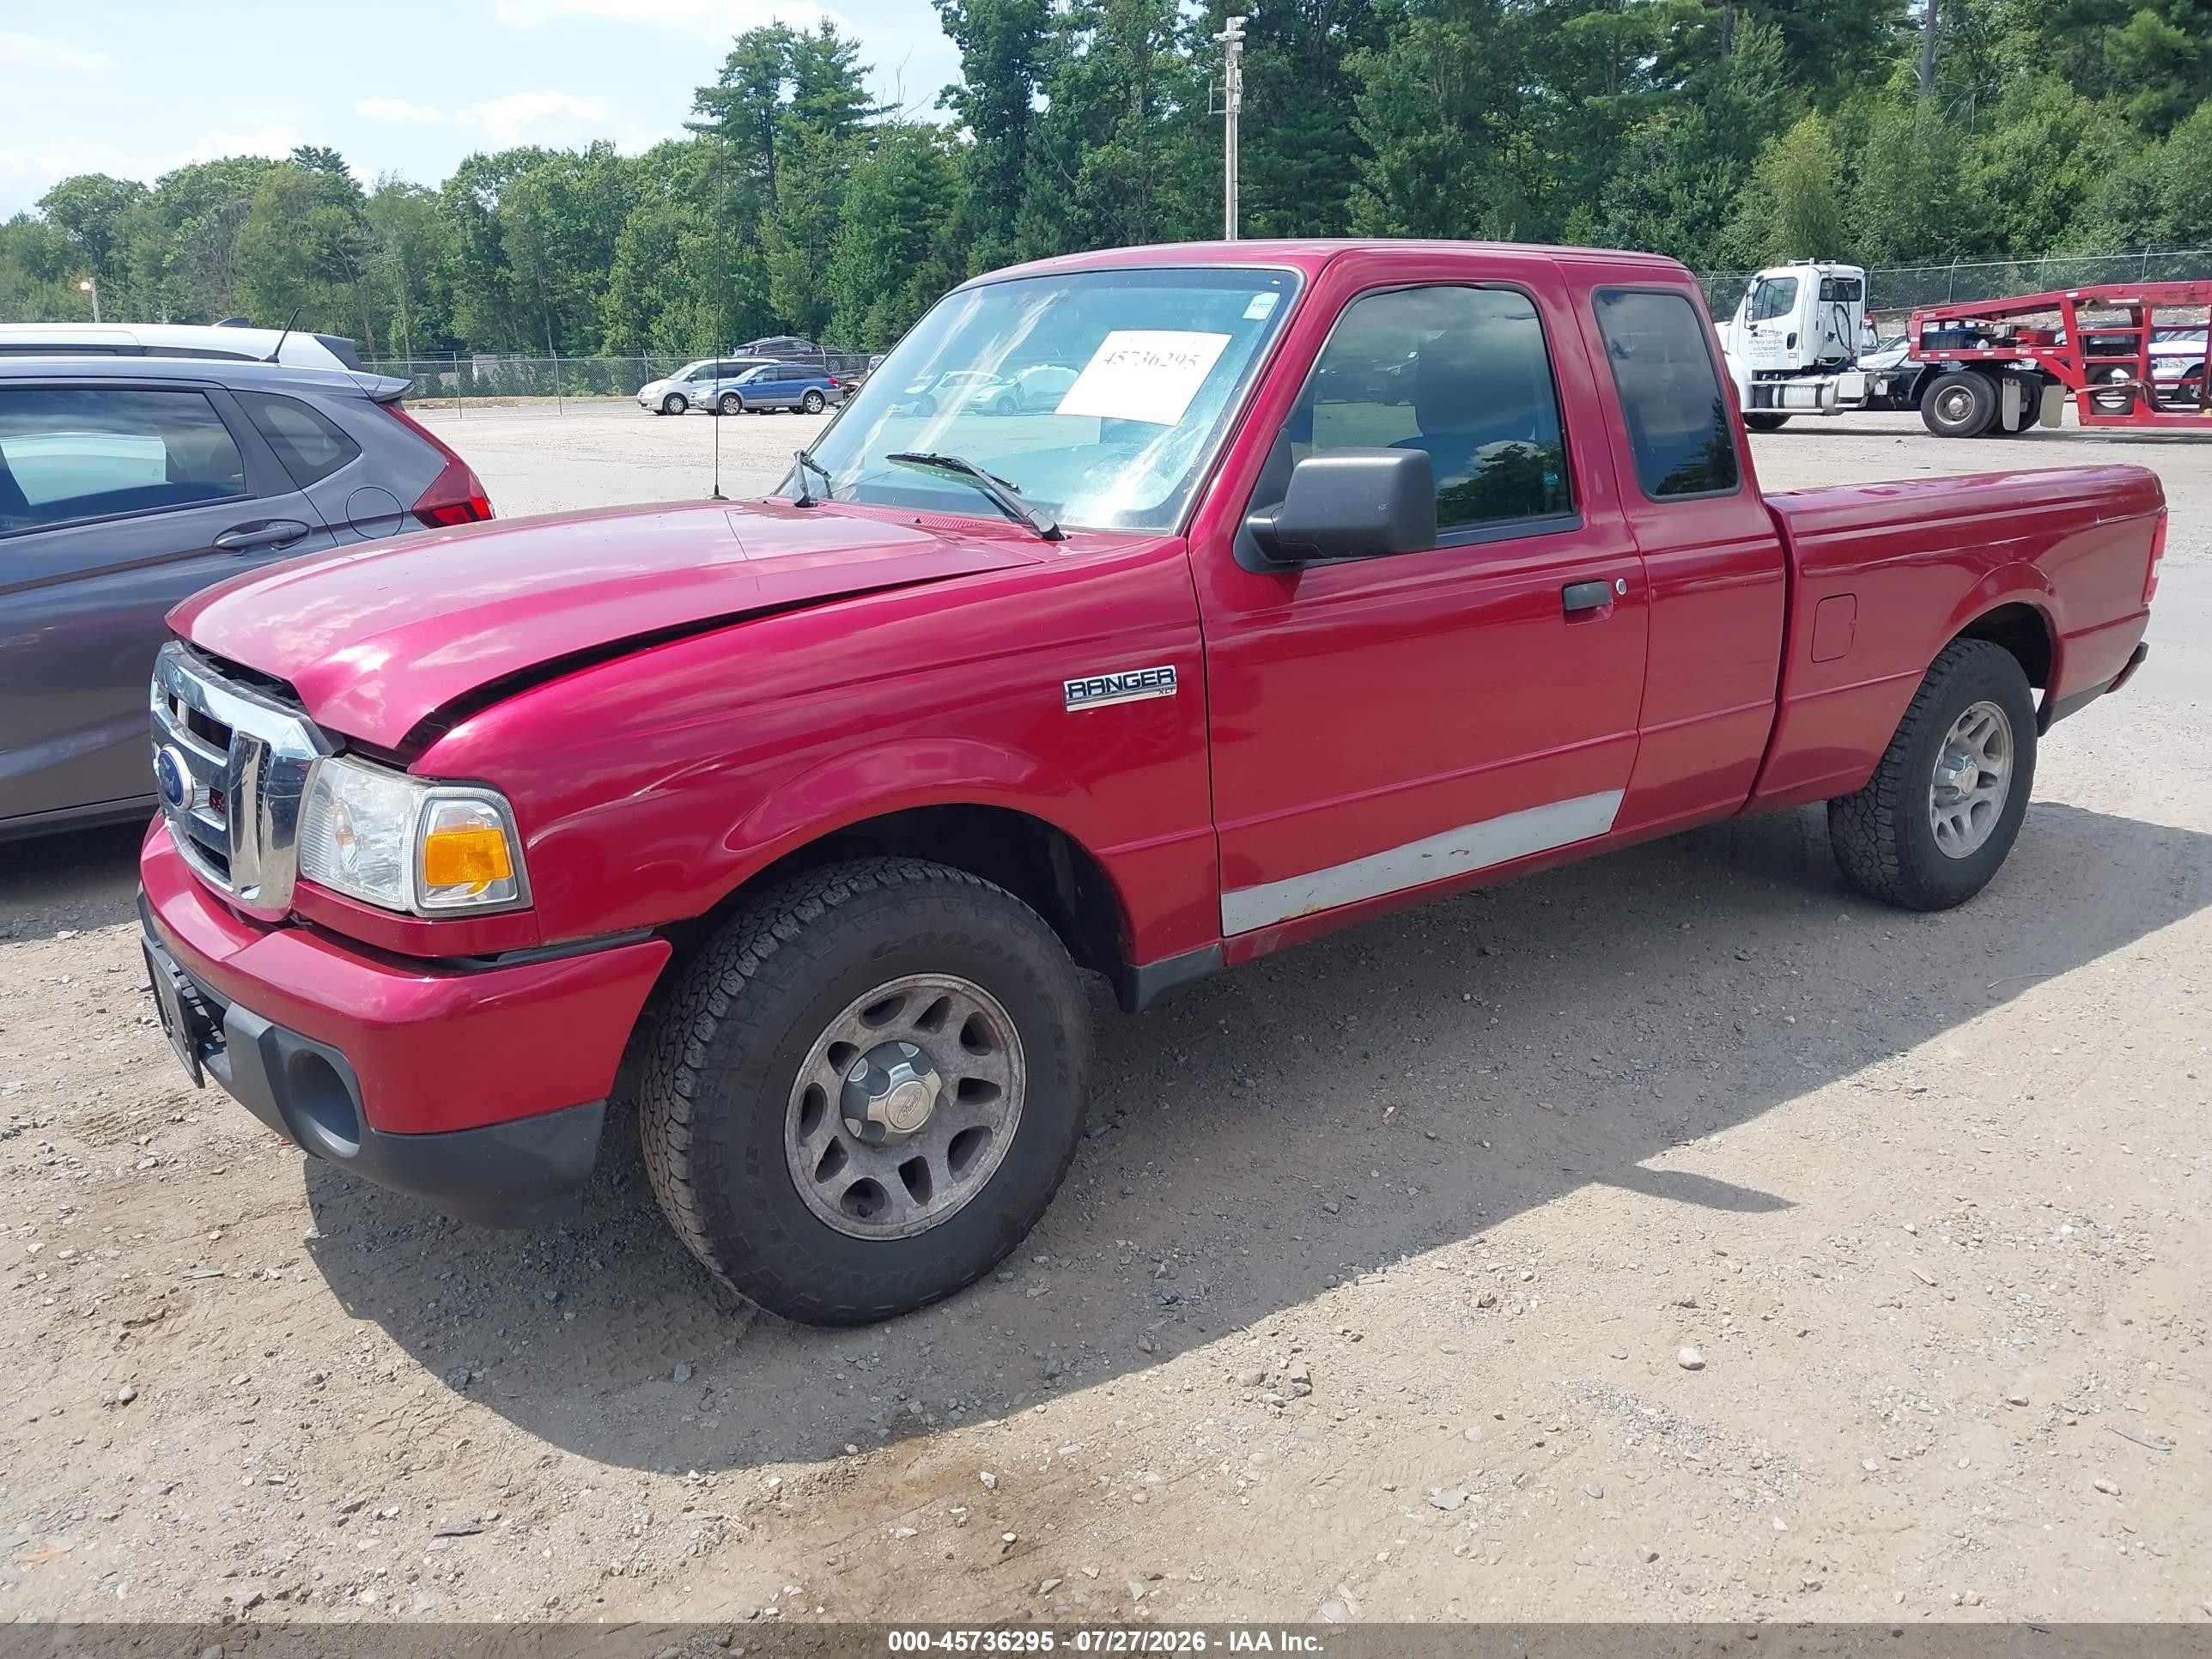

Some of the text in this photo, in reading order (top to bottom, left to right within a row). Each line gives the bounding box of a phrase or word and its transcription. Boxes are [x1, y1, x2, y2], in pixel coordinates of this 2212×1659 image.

[1103, 350, 1201, 369] 45736295
[1066, 667, 1176, 699] RANGER
[1158, 686, 1176, 696] XLT
